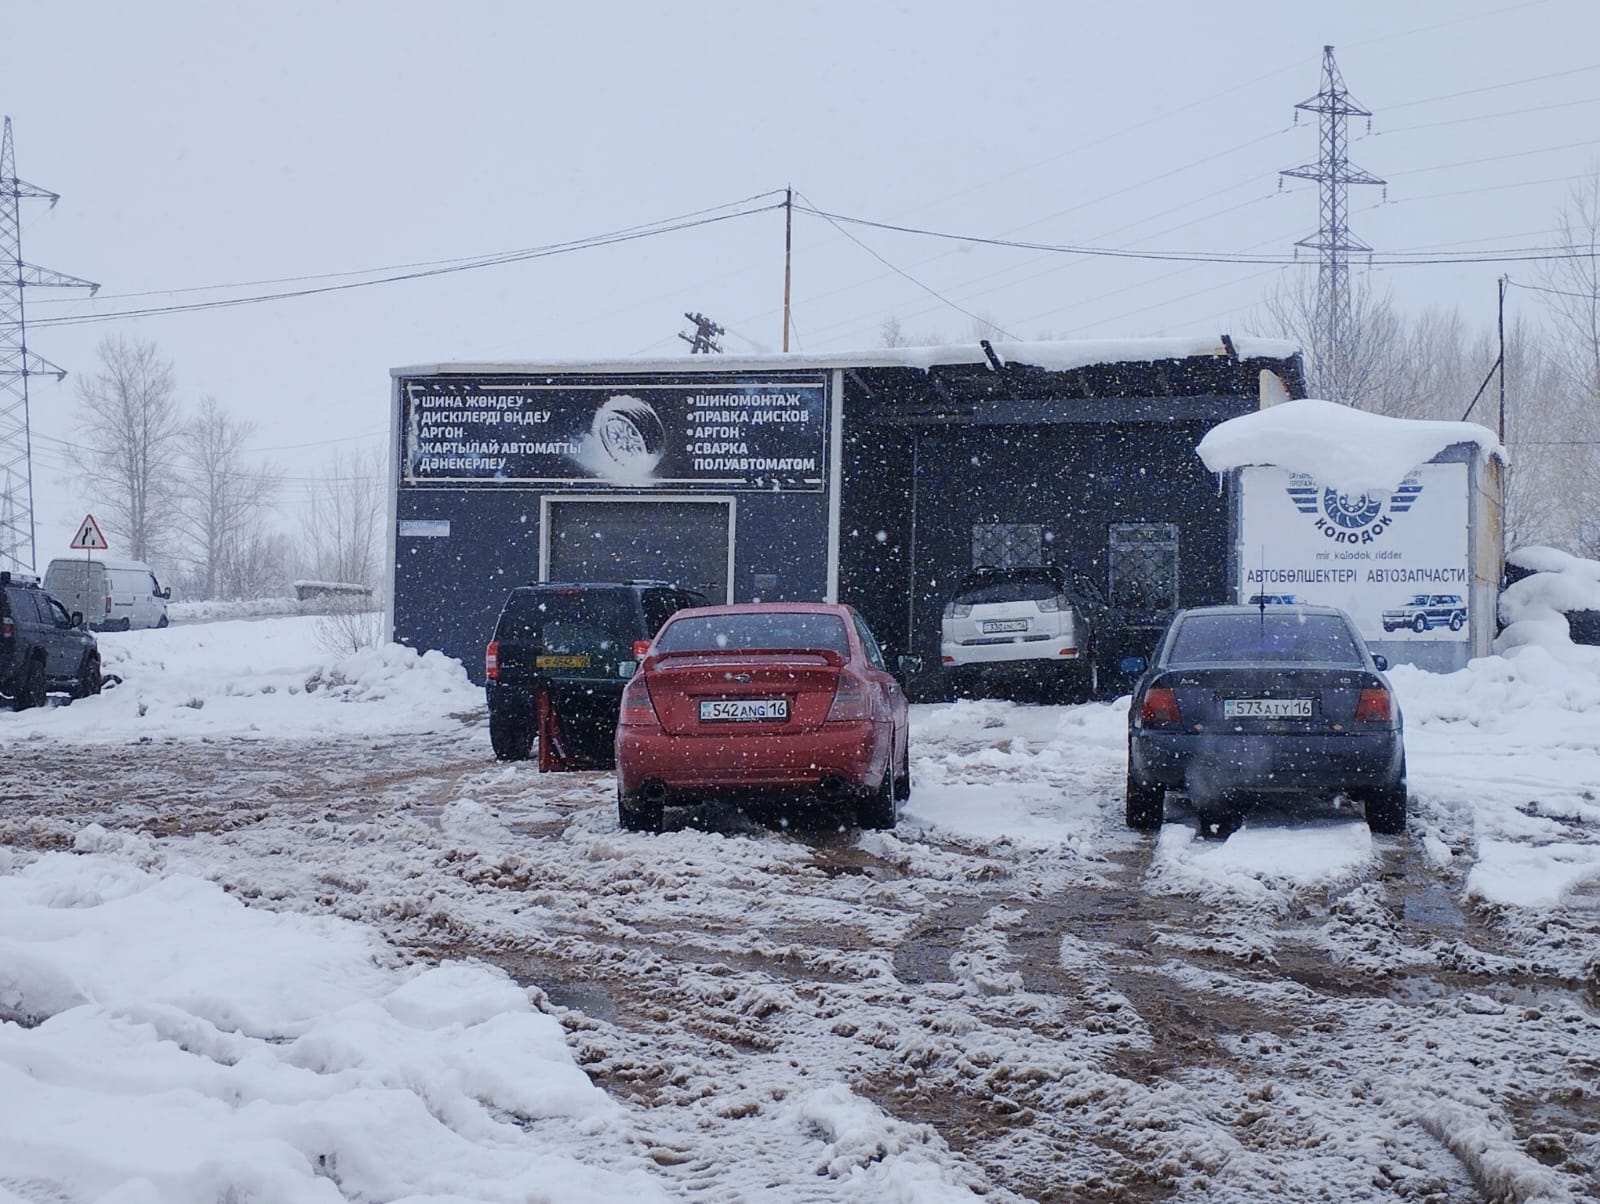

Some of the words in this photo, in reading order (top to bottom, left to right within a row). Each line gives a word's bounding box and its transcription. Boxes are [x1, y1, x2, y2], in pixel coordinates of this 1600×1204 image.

[422, 396, 463, 408] ШИНА
[465, 396, 524, 410] ЖӨНДЕУ
[695, 394, 800, 407] ШИНОМОНТАЖ
[421, 411, 500, 425] ДИСКІЛЕРДІ
[503, 411, 551, 426] ӨҢДЕУ
[695, 411, 749, 422] ПРАВКА
[752, 410, 809, 424] ДИСКОВ
[420, 426, 463, 438] АРГОН
[695, 427, 740, 439] АРГОН
[420, 439, 500, 454] ЖАРТЫЛАЙ
[501, 442, 581, 454] АВТОМАТТЫ
[695, 443, 749, 454] СВАРКА
[420, 458, 506, 472] ДӘНЕКЕРЛЕУ
[694, 458, 815, 471] ПОЛУАВТОМАТОМ
[1314, 515, 1393, 545] КОЛОДОК
[1247, 568, 1357, 583] АВТОБӨЛШЕКТЕРІ
[1367, 568, 1466, 582] АВТОЗАПЧАСТИ
[713, 703, 765, 717] 542ANG
[769, 702, 785, 716] 16
[1236, 701, 1289, 714] 573AIY
[1294, 702, 1310, 714] 16
